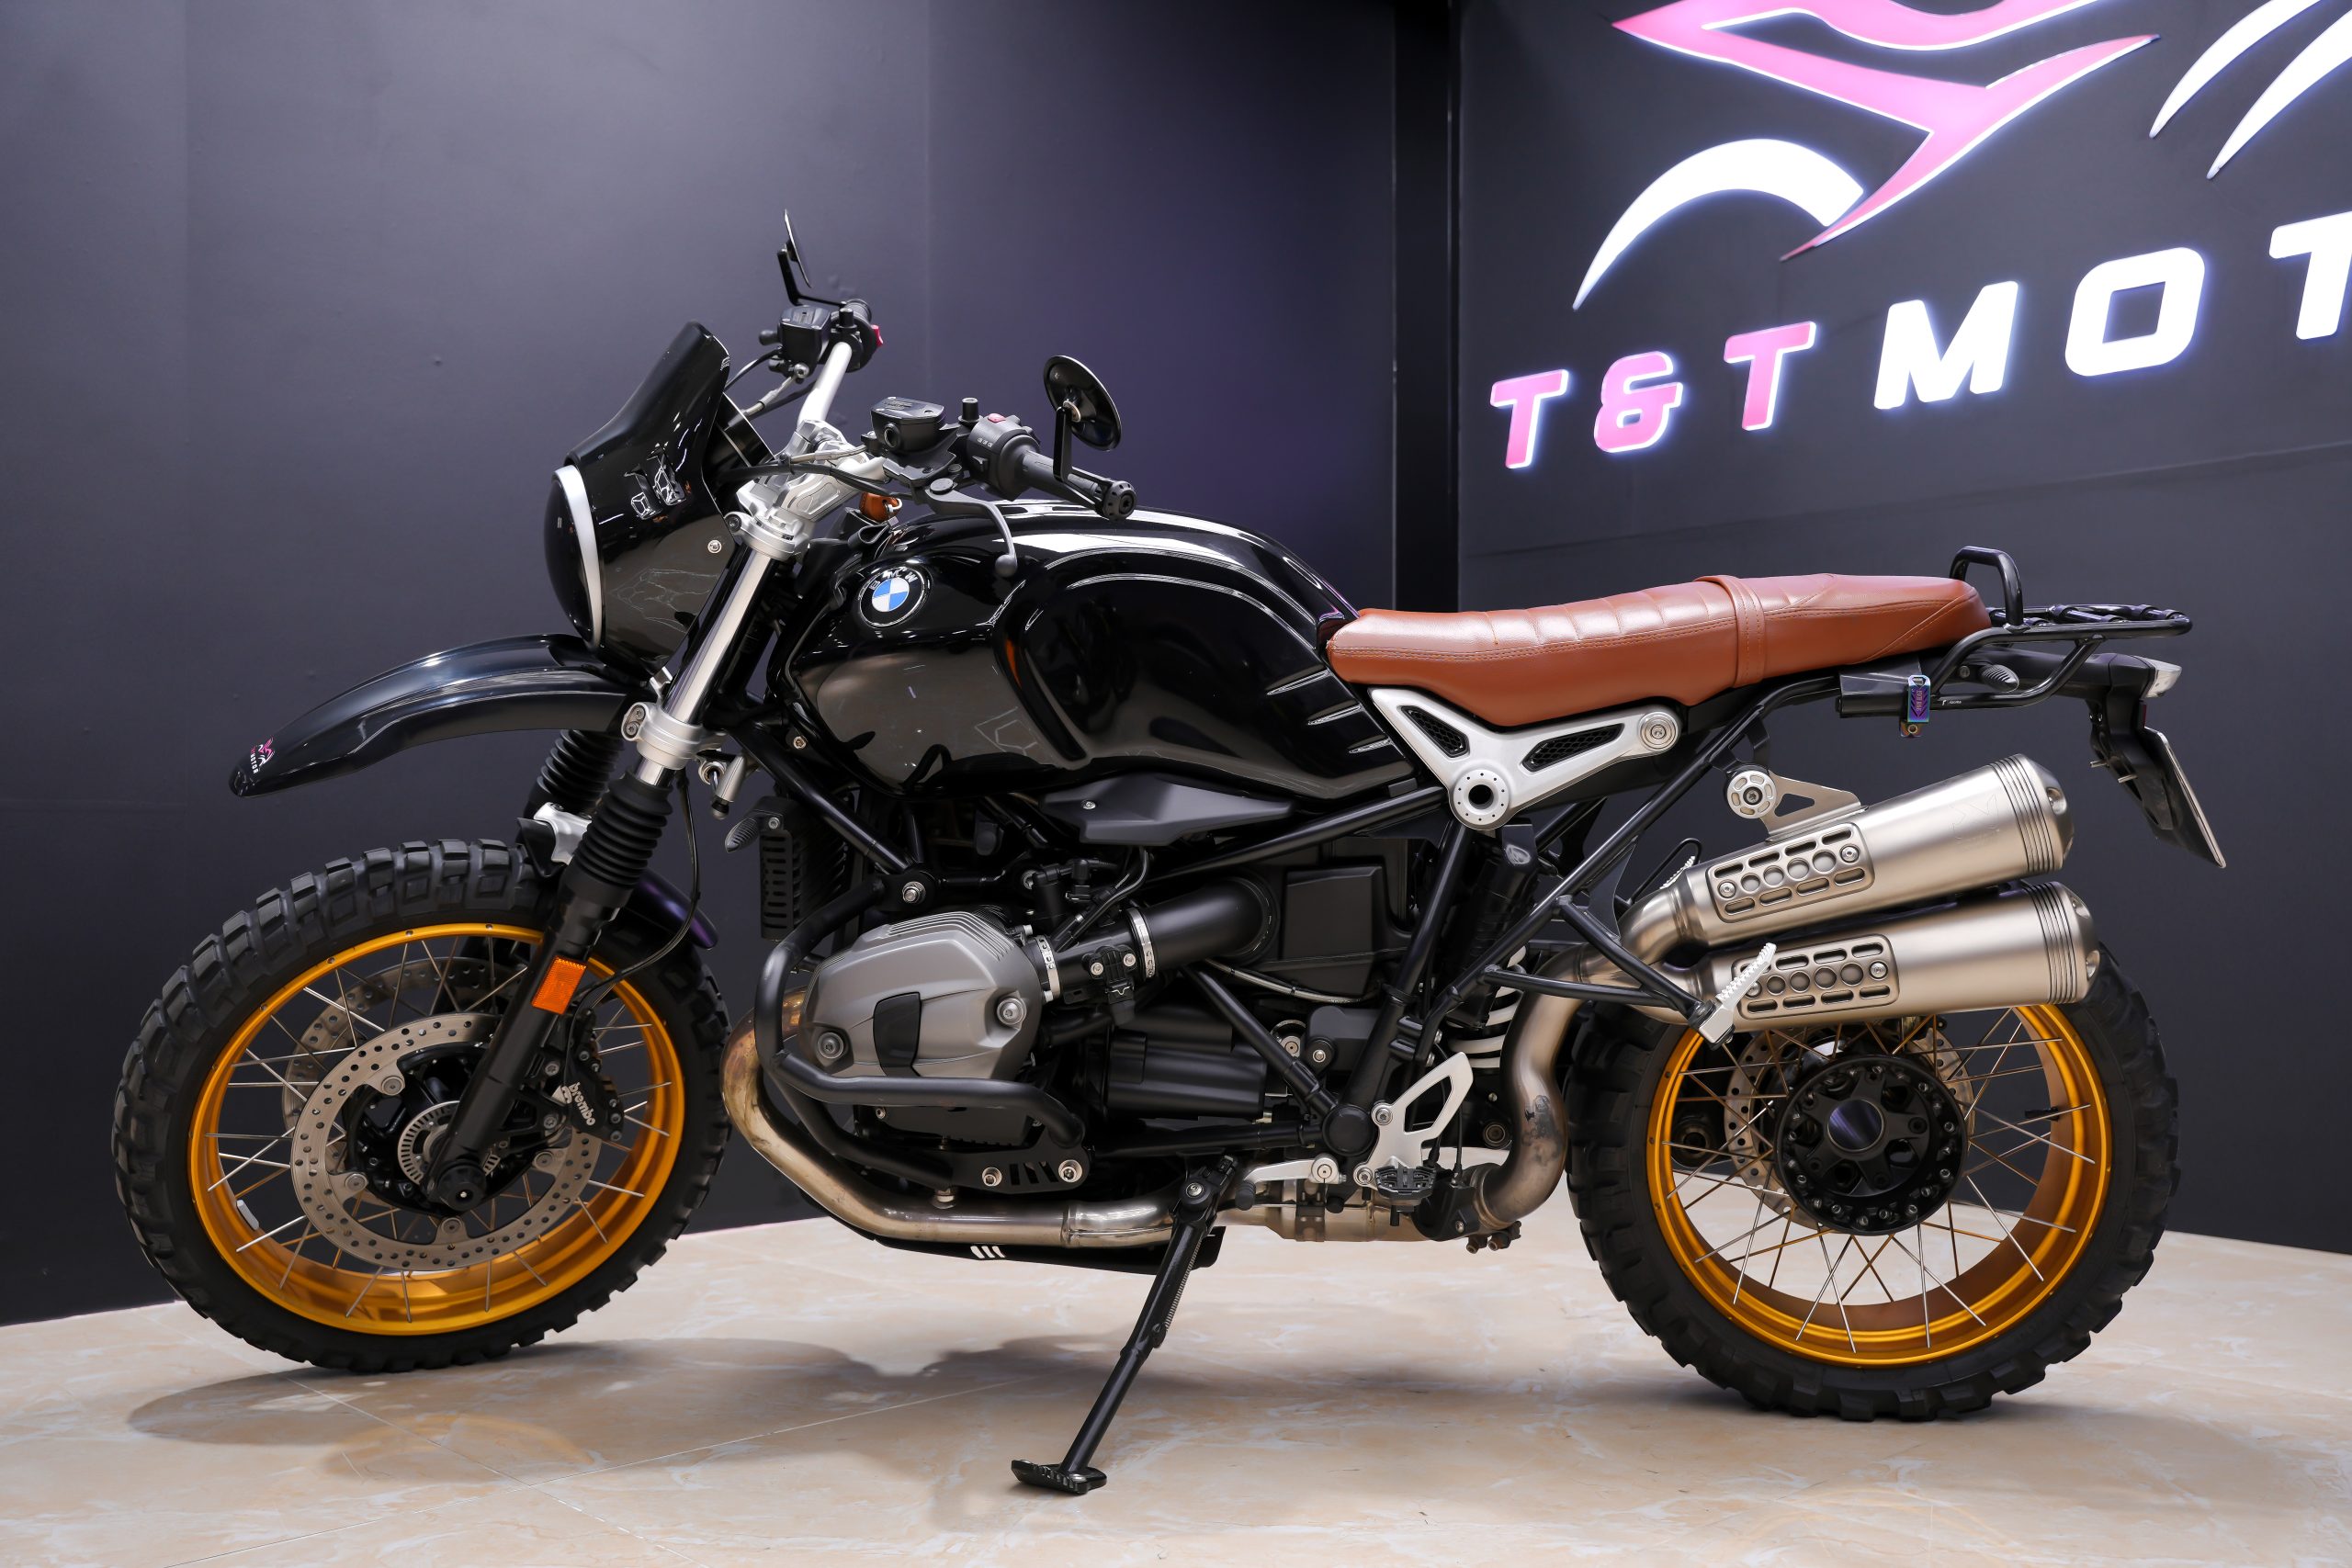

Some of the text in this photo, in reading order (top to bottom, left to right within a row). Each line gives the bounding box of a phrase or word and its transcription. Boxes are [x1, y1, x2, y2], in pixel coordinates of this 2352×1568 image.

[1488, 321, 1817, 468] T&T
[868, 570, 918, 590] BMW
[569, 1082, 595, 1125] brembo
